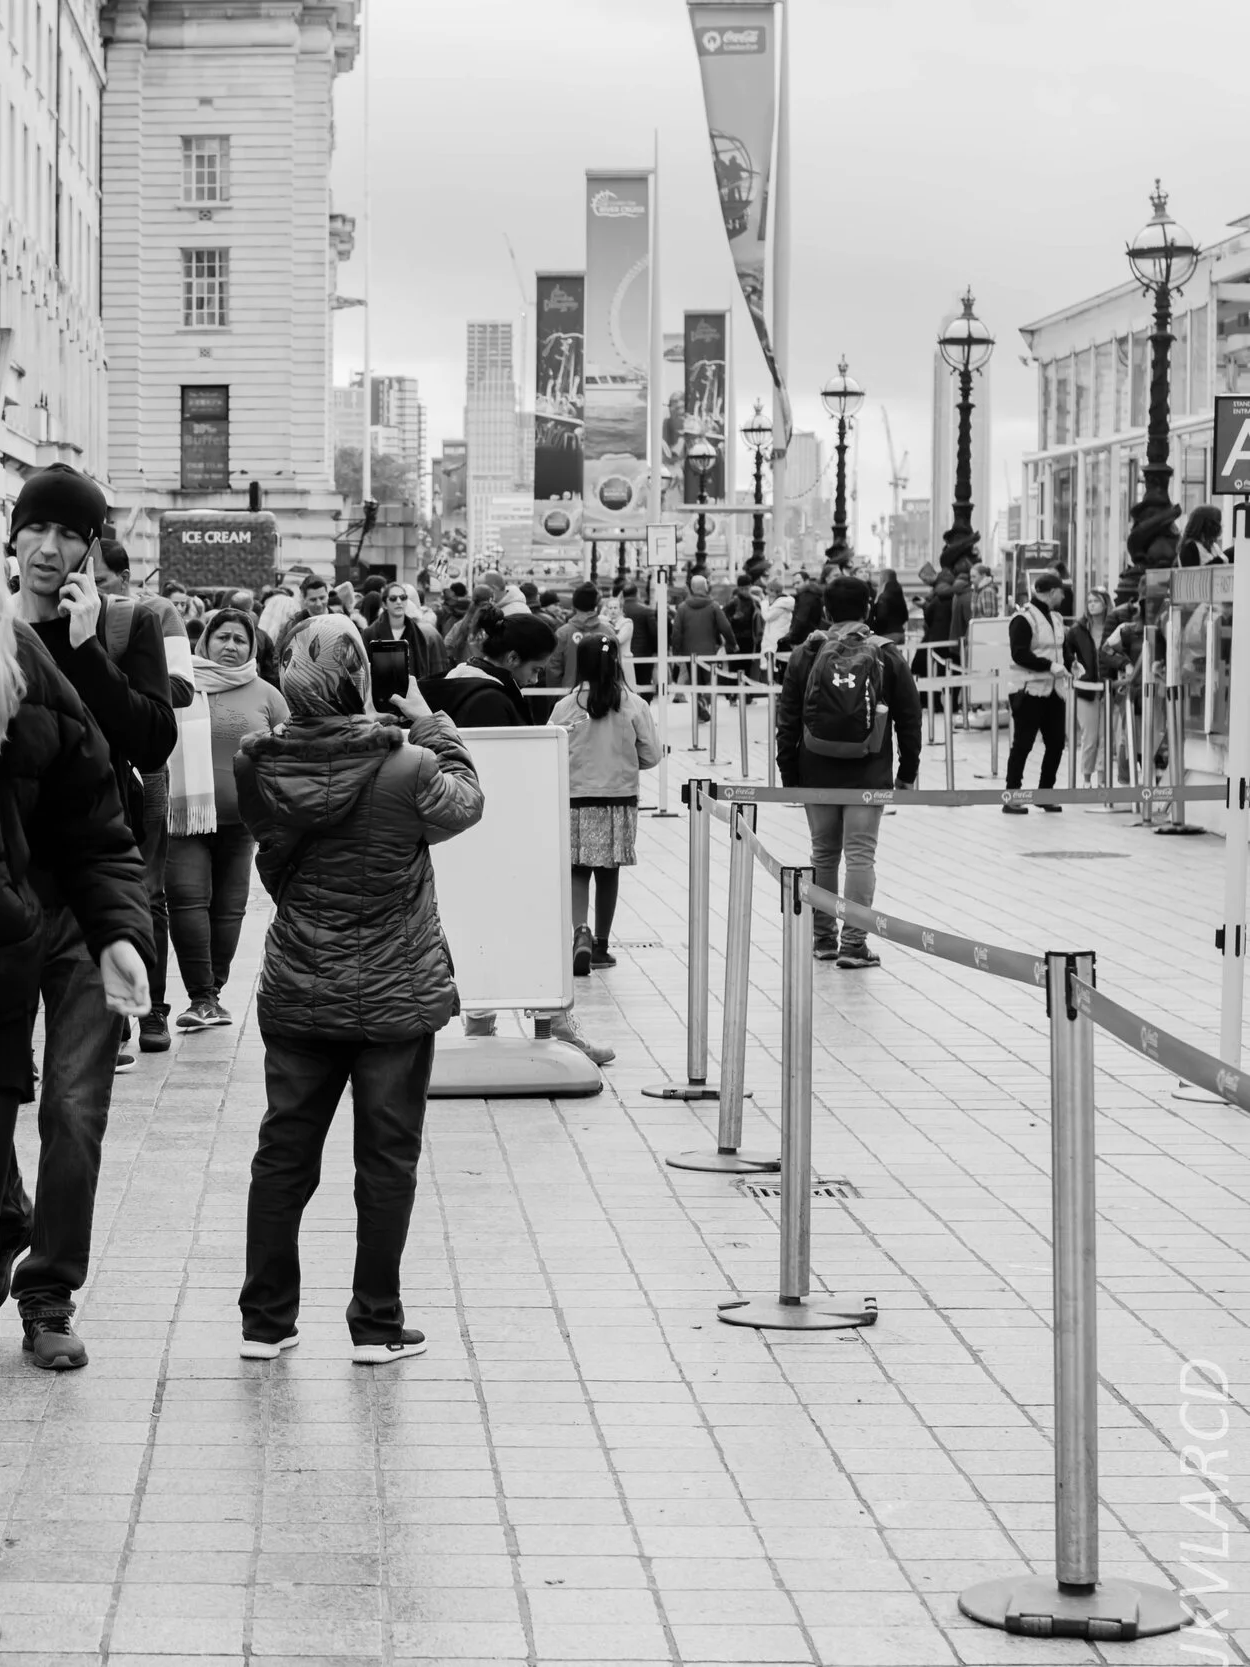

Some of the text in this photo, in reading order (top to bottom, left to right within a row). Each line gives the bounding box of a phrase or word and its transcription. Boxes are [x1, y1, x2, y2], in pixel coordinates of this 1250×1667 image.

[182, 531, 252, 544] ICE CREAM
[655, 536, 669, 556] F
